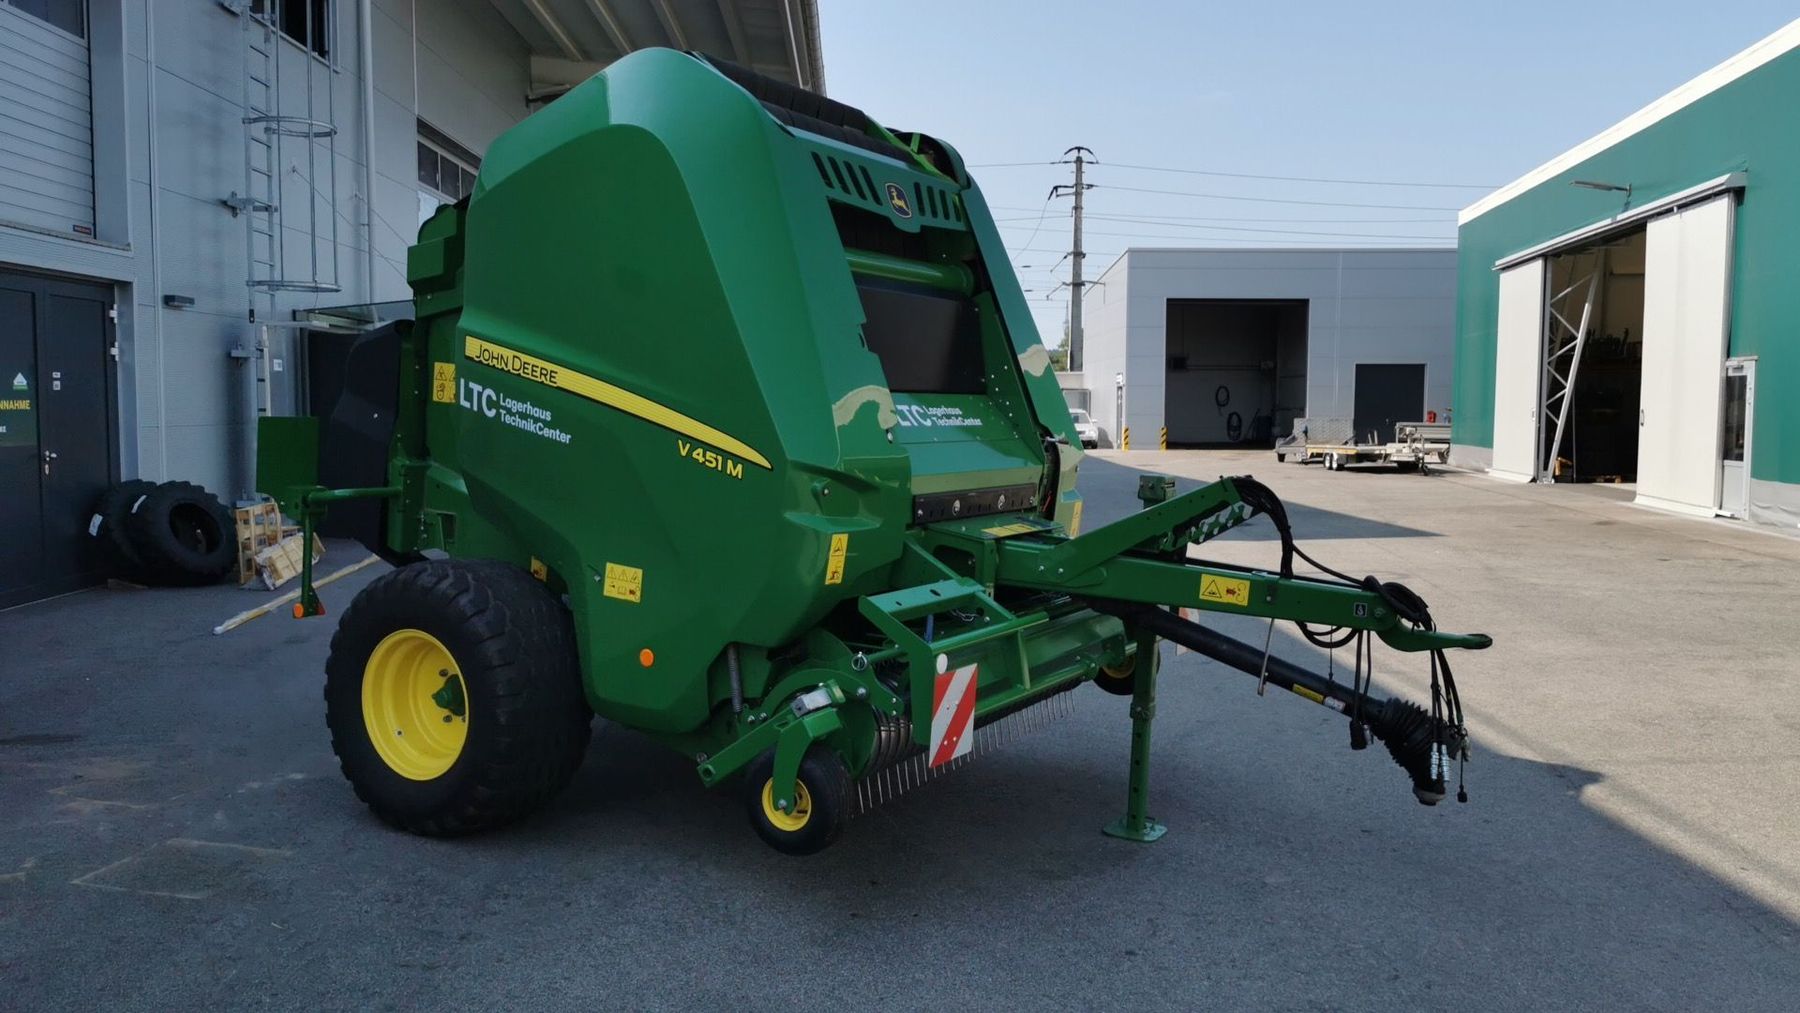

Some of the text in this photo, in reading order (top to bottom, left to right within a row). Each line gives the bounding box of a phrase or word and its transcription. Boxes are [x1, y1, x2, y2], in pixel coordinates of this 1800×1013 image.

[475, 344, 558, 384] JOHN DEERE
[459, 378, 497, 418] LTC
[500, 393, 552, 421] Lagerhaus
[500, 409, 572, 444] TechnikCenter
[678, 440, 743, 479] V 451 M
